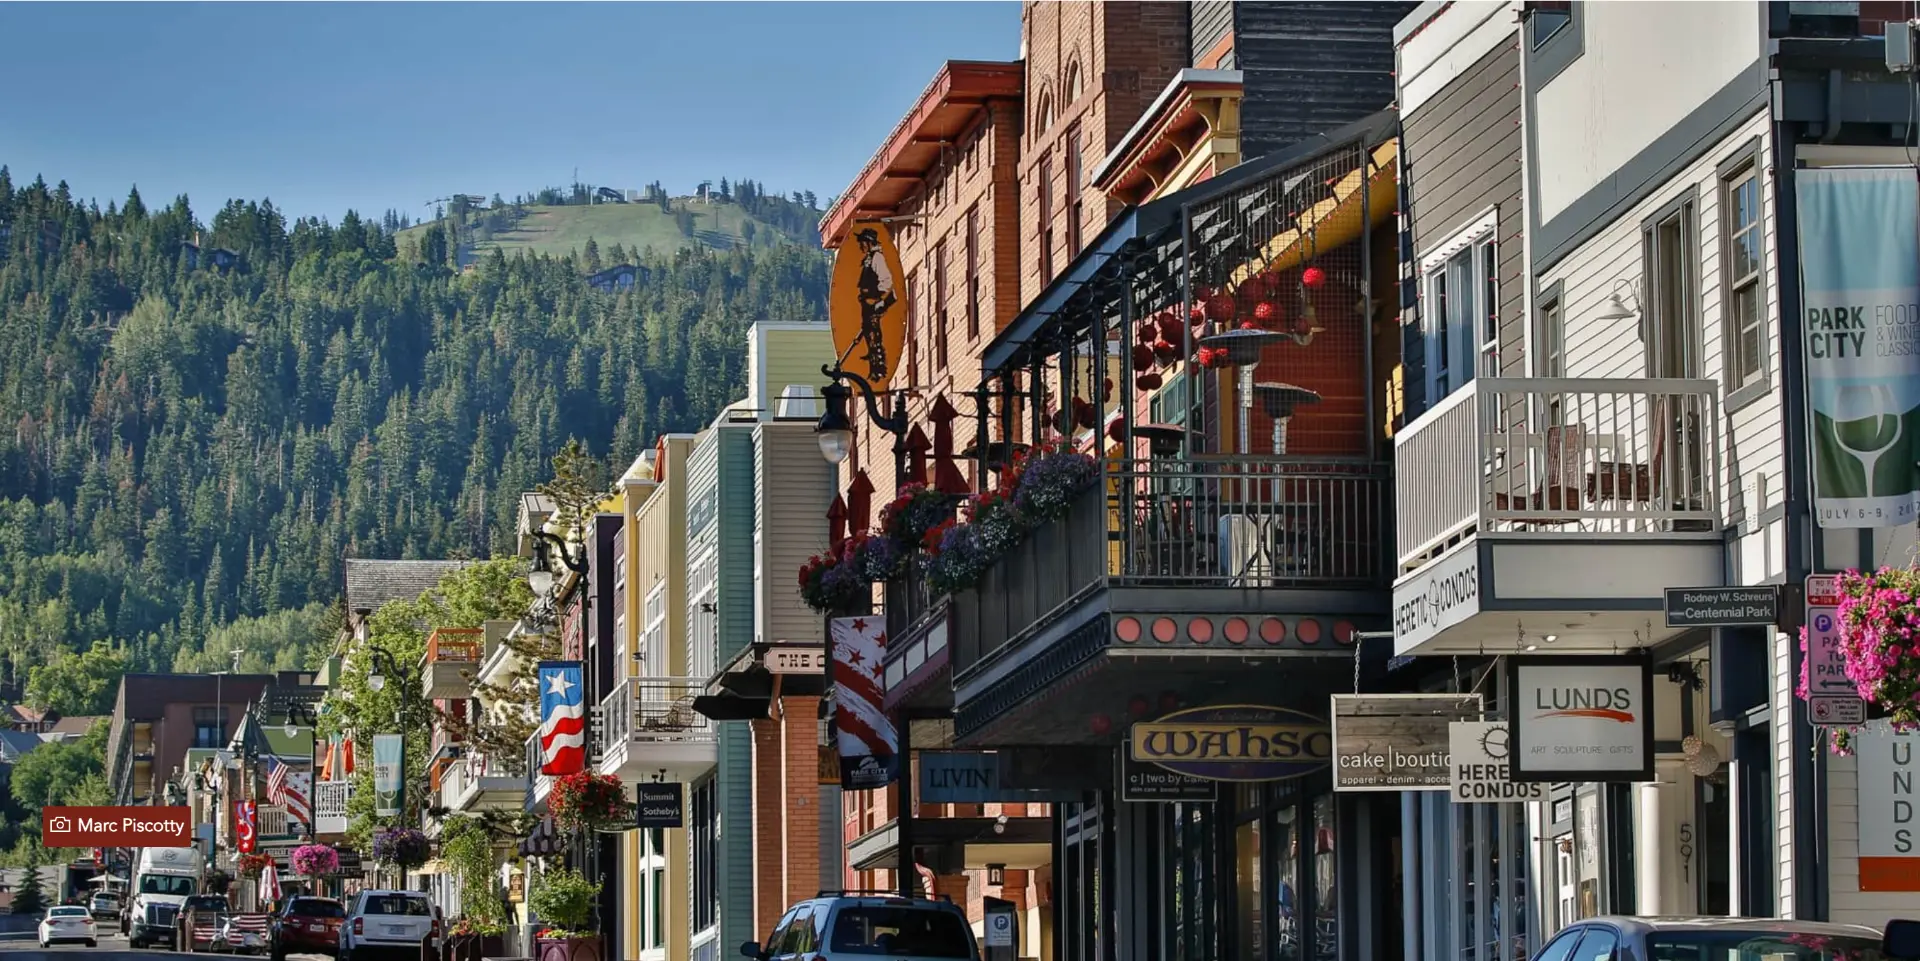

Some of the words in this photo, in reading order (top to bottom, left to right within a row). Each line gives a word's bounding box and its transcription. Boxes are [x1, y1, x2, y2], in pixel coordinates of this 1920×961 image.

[1808, 306, 1866, 330] PARK
[1876, 304, 1919, 326] FOOD
[1877, 327, 1884, 341] &
[1888, 325, 1920, 341] WINE
[1810, 332, 1866, 359] CITY
[1876, 340, 1920, 357] CLASSIC
[1395, 593, 1428, 639] HERETIC
[1440, 565, 1477, 612] CONDOS
[1684, 593, 1719, 604] Rodney
[1720, 593, 1732, 602] W.
[1733, 592, 1774, 602] Schreurs
[1685, 606, 1744, 618] Centennial
[1746, 606, 1772, 617] Park
[1822, 636, 1839, 647] PA
[778, 654, 810, 667] THE
[1817, 664, 1844, 675] PAR
[1536, 688, 1630, 710] LUNDS
[1531, 746, 1546, 754] ART
[1553, 746, 1602, 755] SCULPTURE
[1609, 746, 1634, 754] GIFTS
[1340, 752, 1385, 768] cake
[1147, 774, 1165, 783] two
[1168, 774, 1181, 785] by
[1341, 776, 1377, 785] apparel
[1387, 775, 1415, 784] denim
[1425, 776, 1451, 784] acces
[1459, 764, 1509, 780] HERE
[643, 792, 674, 801] Summit
[1459, 782, 1541, 798] CONDOS
[1892, 729, 1913, 853] UNDS
[643, 807, 679, 816] Sotheby's
[1679, 823, 1693, 884] 591
